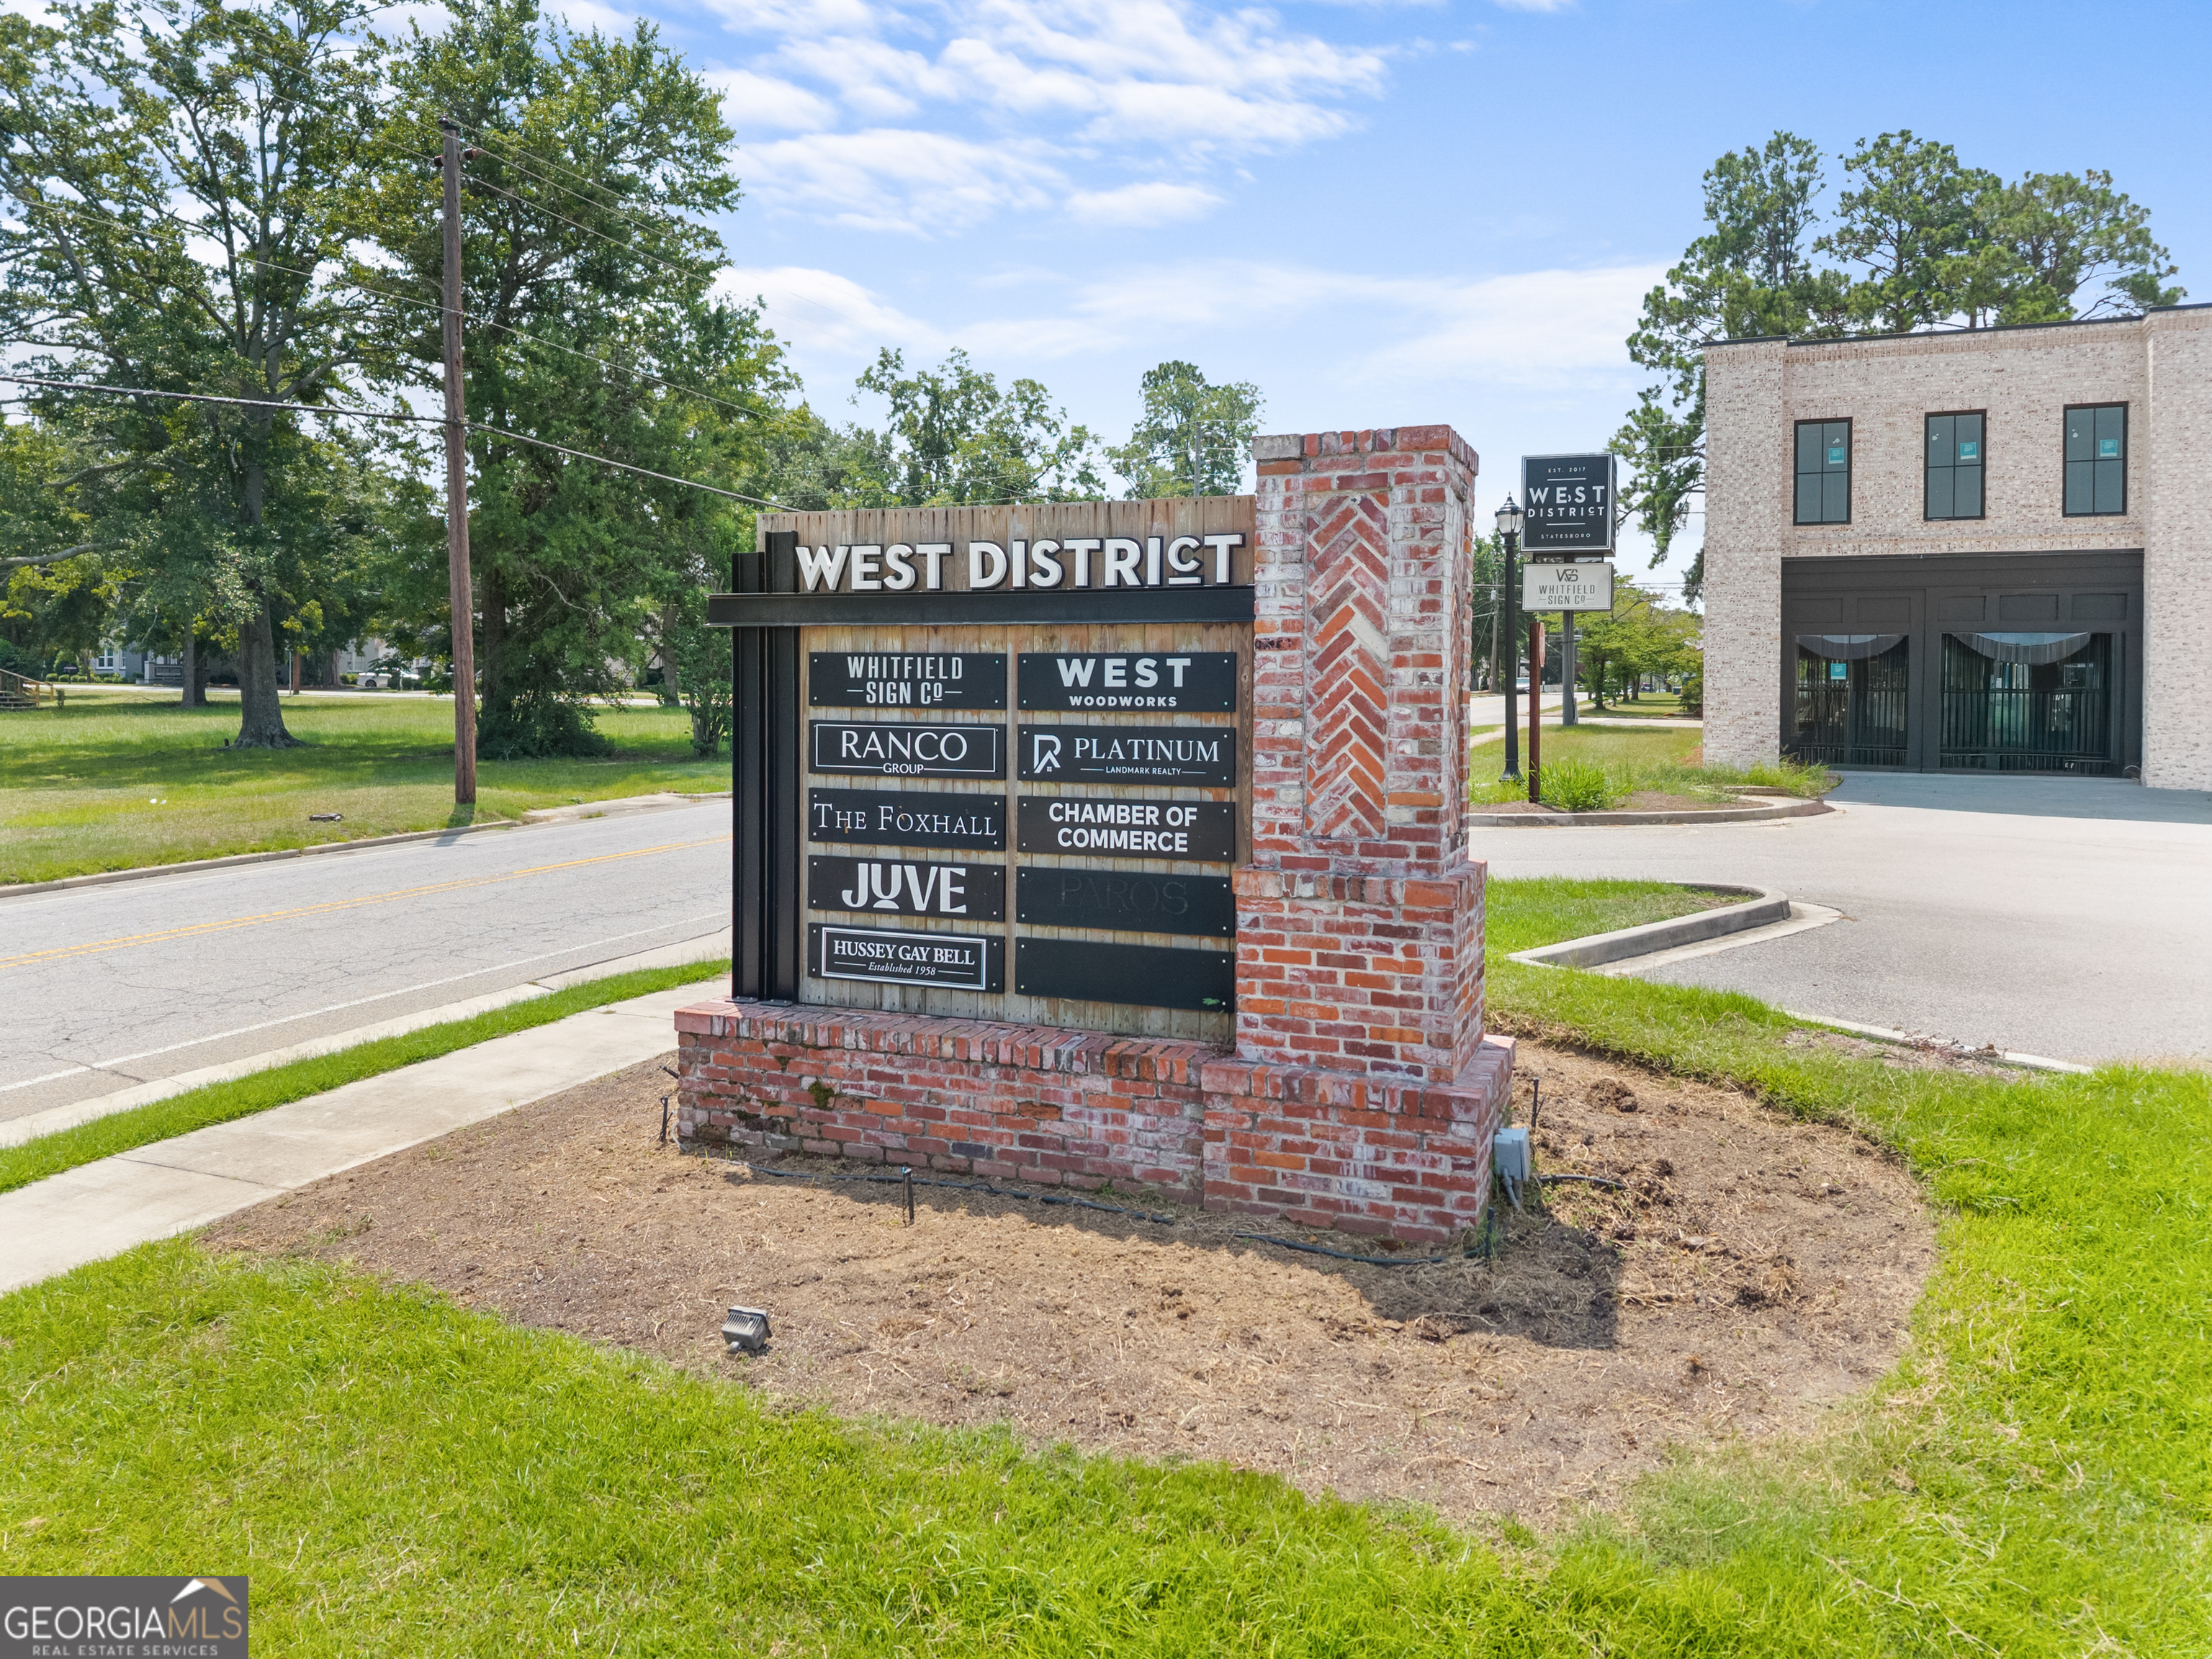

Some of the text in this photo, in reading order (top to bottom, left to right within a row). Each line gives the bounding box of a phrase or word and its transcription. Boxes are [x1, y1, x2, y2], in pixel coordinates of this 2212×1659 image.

[1529, 485, 1605, 505] WEST
[1527, 506, 1605, 518] DISTRICT
[795, 533, 1244, 591] WEST DISTRICT
[1539, 584, 1596, 595] WHITFIELD
[1547, 595, 1570, 605] SIGN
[847, 656, 963, 679] WHITFIELD
[1056, 658, 1192, 688] WEST
[866, 681, 912, 704] SIGN
[1069, 696, 1178, 707] WOODWORKS
[841, 730, 968, 762] RANCO
[1074, 737, 1220, 763] PLATINUM
[883, 763, 925, 774] GROUP
[1105, 765, 1182, 775] LANDMARK REALTY
[1048, 802, 1198, 827] CHAMBER OF
[1057, 827, 1188, 853] COMMERCE
[841, 863, 967, 914] JUVE
[1056, 875, 1189, 915] PAROS
[833, 940, 976, 966] HUSSEY GAY BELL
[868, 962, 937, 976] Established 1958
